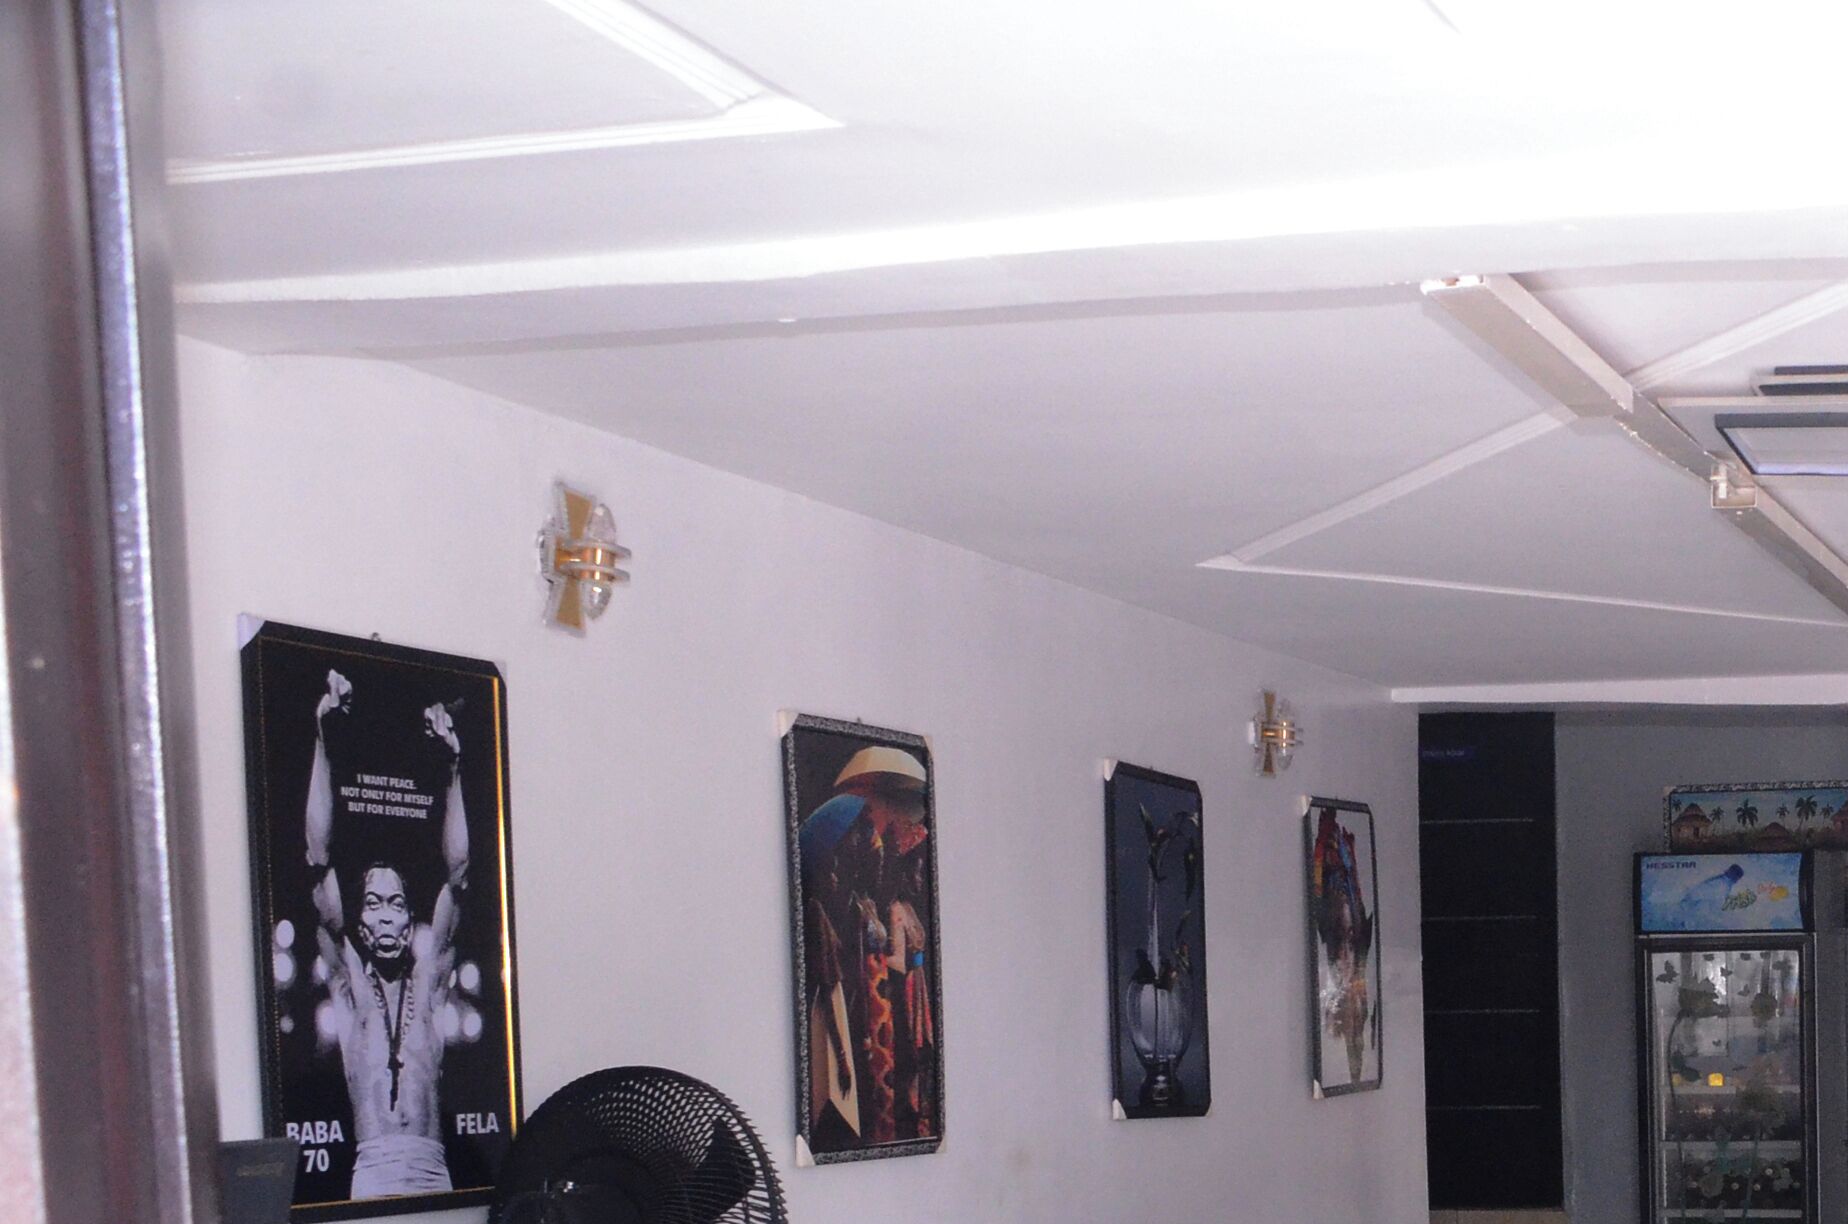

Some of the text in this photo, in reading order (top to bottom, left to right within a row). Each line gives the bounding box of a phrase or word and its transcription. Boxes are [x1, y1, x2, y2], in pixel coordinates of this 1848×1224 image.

[362, 774, 388, 786] WANT
[341, 786, 434, 805] NOT ONLY FOR MYSELF
[348, 801, 427, 819] BUT FOR EVERYONE
[286, 1120, 344, 1145] BABA
[456, 1112, 499, 1135] FELA
[303, 1148, 330, 1173] 70
